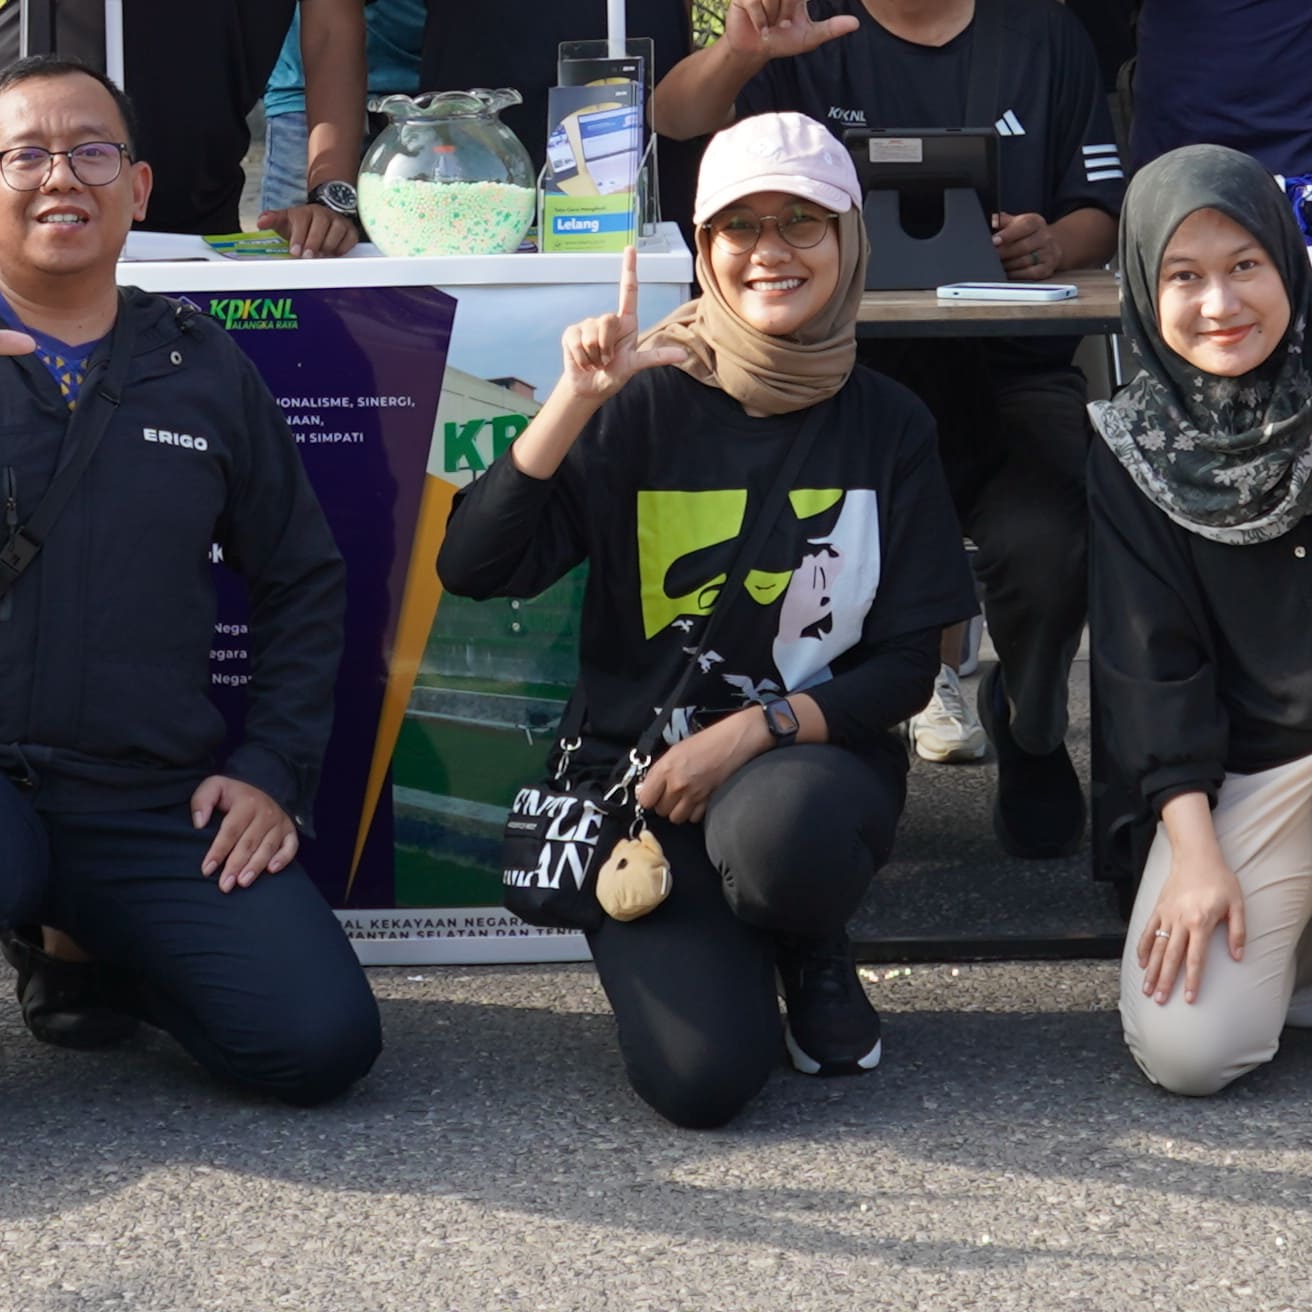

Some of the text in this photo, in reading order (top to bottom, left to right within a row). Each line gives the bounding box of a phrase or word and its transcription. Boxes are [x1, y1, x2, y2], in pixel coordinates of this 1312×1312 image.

[557, 217, 600, 233] Lelang
[209, 298, 298, 330] KPKNL
[357, 396, 416, 407] SINERGI,
[143, 428, 208, 451] ERIGO
[309, 432, 364, 443] SIMPATI
[370, 918, 457, 929] KEKAYAAN
